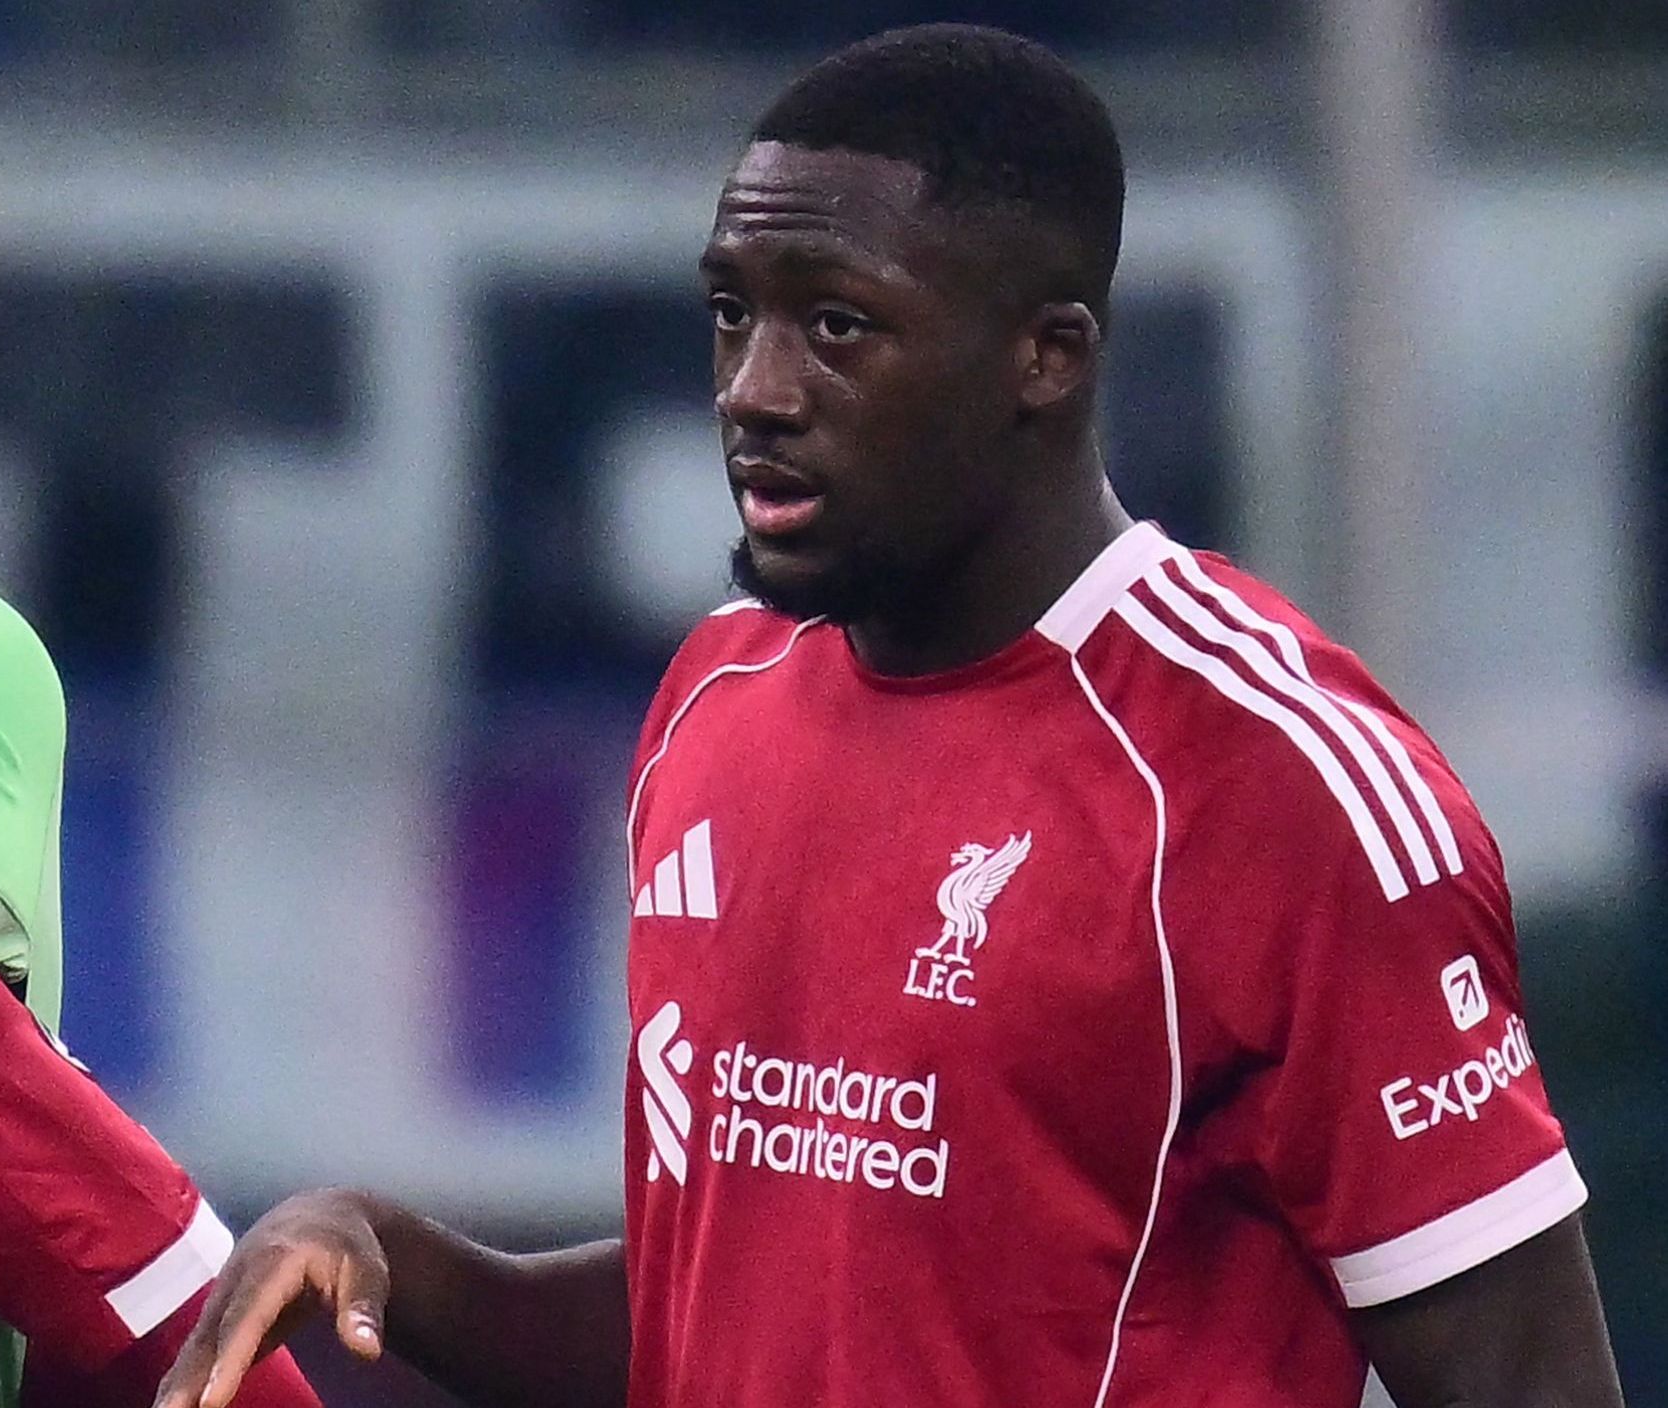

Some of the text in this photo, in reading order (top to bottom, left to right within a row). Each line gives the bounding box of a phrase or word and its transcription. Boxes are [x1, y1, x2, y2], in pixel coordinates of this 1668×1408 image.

[711, 1041, 938, 1131] standard
[1380, 1012, 1535, 1141] Expedi
[709, 1105, 949, 1198] chartered
